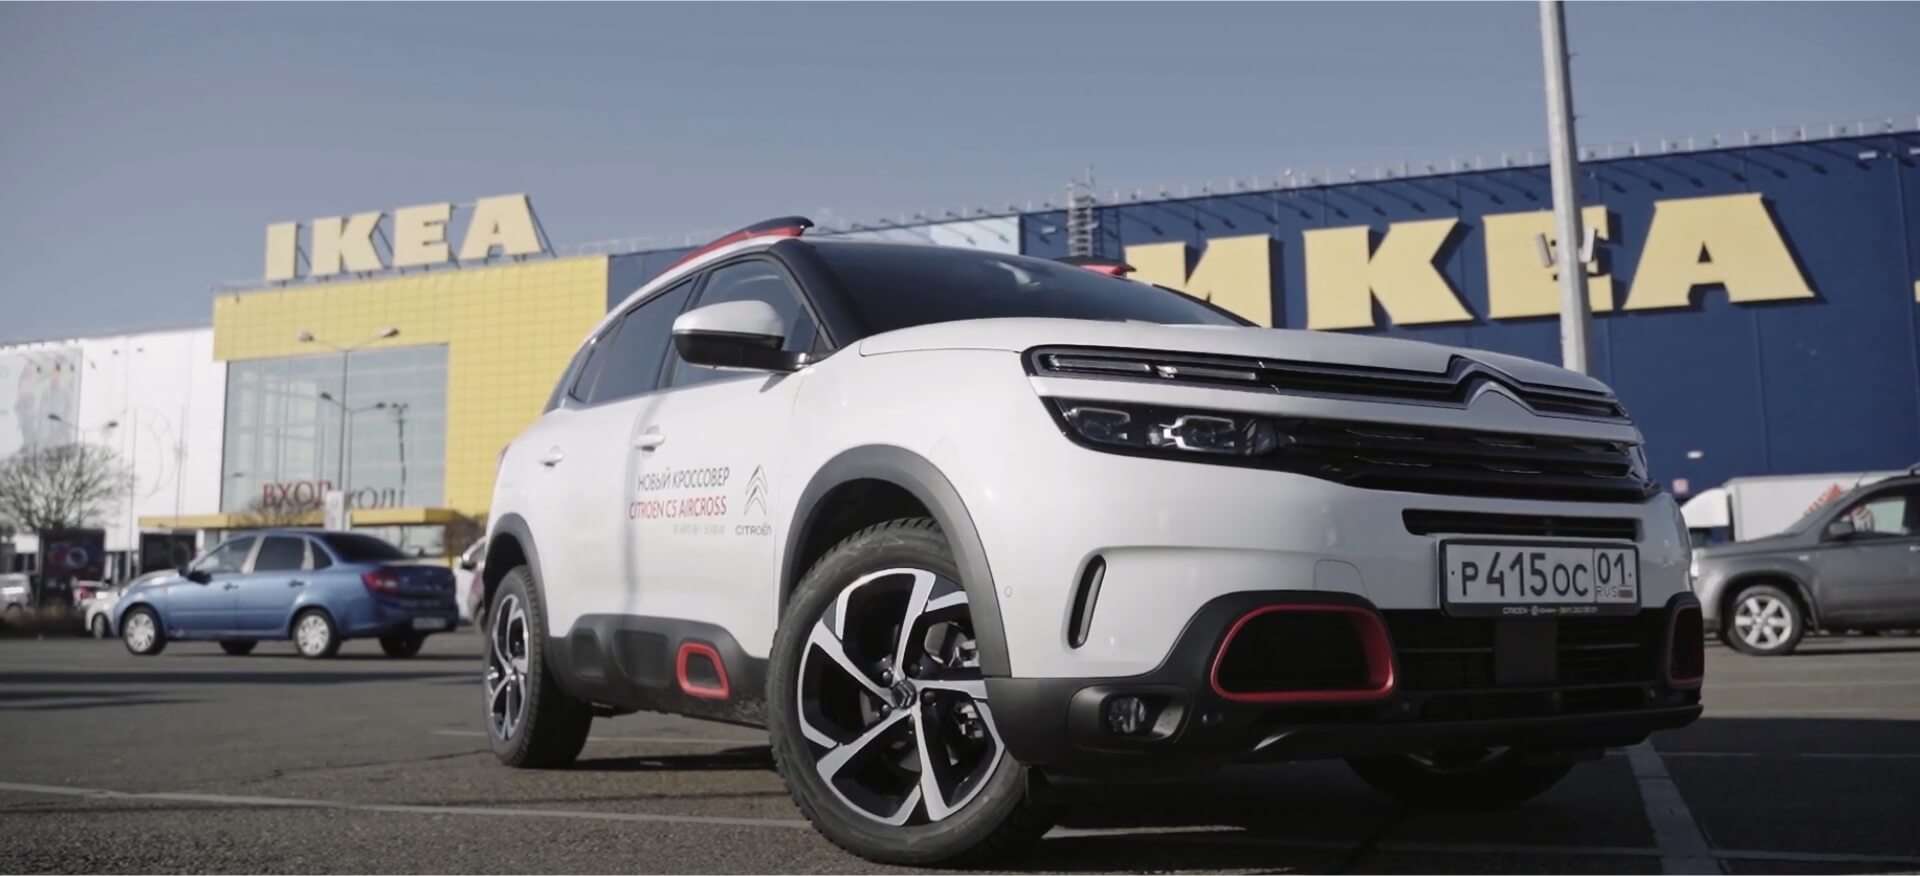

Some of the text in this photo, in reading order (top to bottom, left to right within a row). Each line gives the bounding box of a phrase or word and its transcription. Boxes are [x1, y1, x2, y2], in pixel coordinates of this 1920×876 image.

[265, 193, 543, 282] IKEA
[637, 466, 730, 492] НОВЫЙ КРОССОВЕР
[665, 499, 678, 518] C5
[678, 495, 727, 518] AIRCROSS
[1597, 552, 1626, 585] 01
[1597, 585, 1618, 598] RUS
